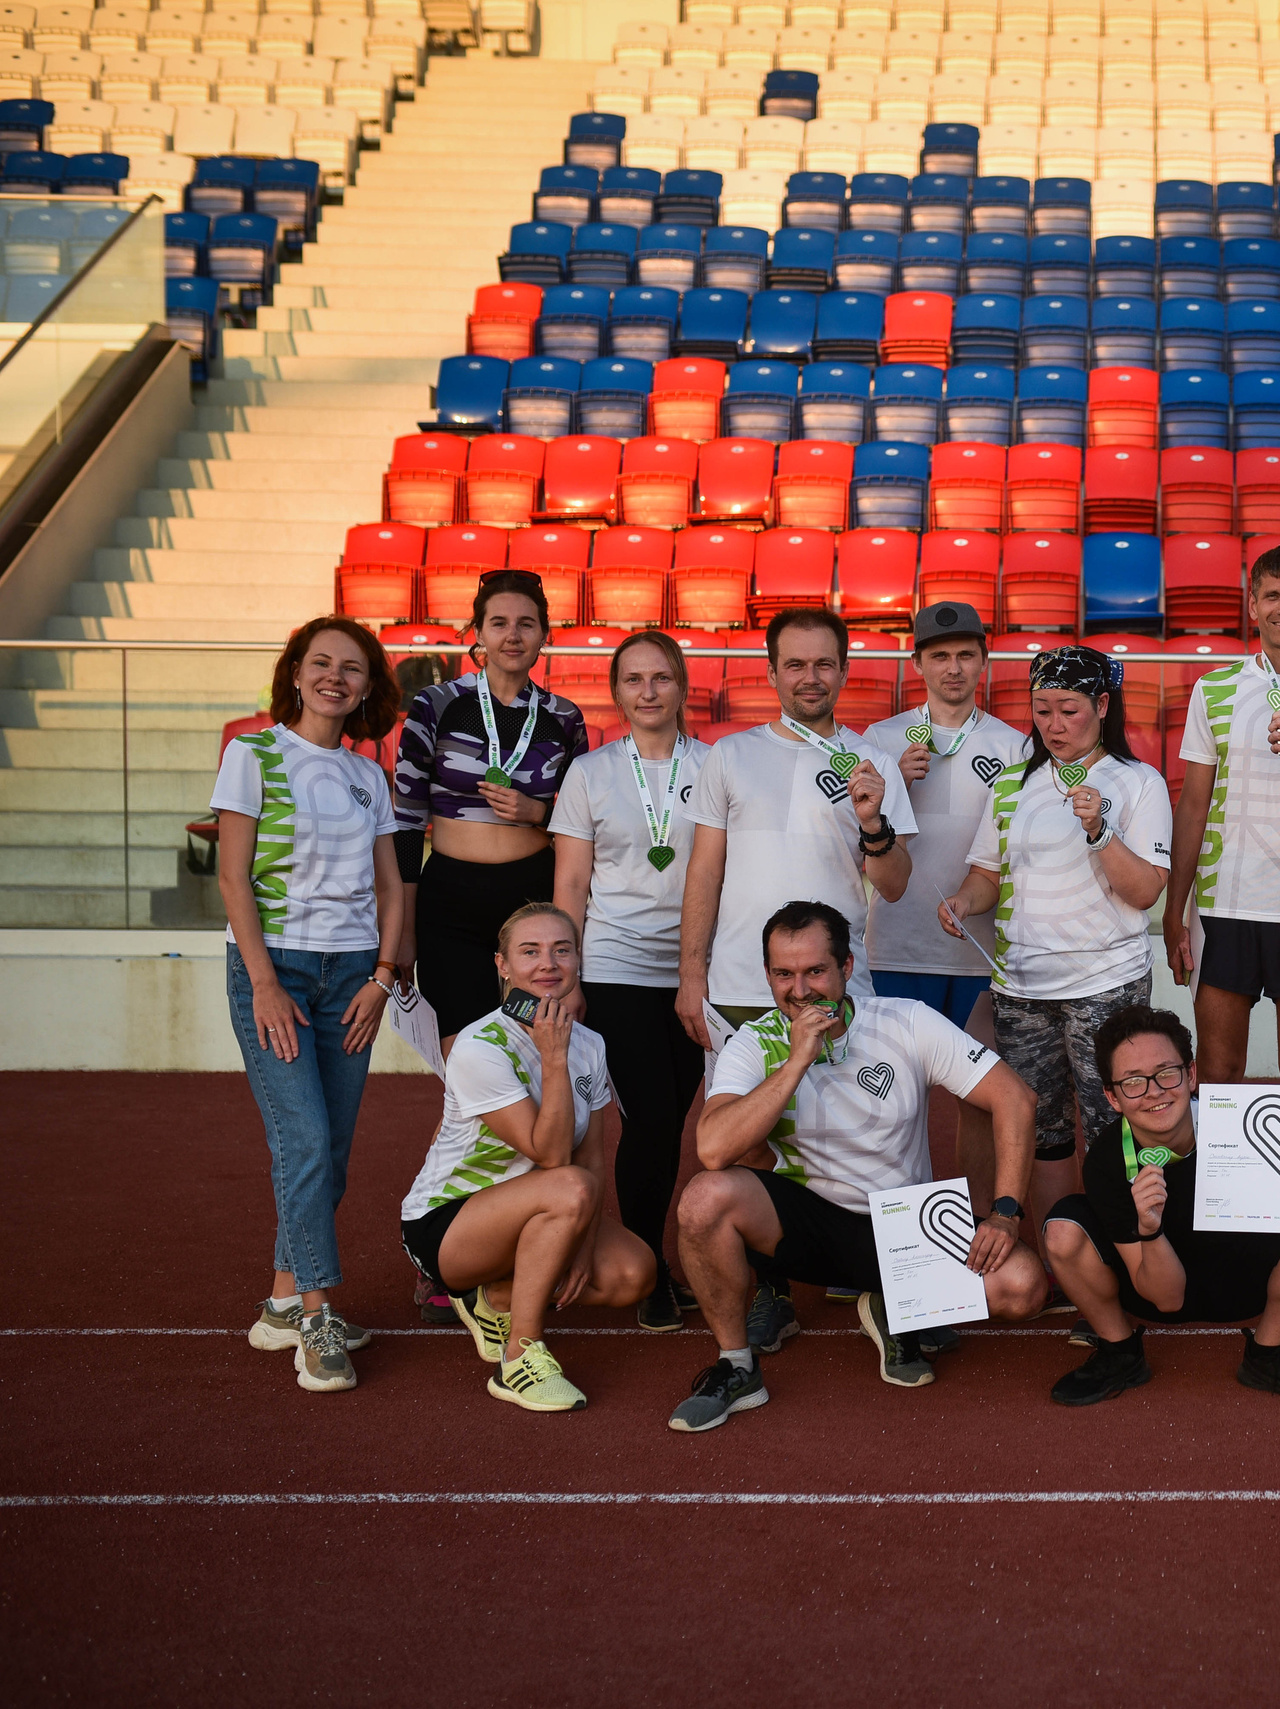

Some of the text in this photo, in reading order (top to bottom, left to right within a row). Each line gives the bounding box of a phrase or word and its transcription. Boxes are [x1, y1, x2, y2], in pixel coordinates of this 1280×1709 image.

[633, 761, 646, 789] RUNNING
[669, 758, 680, 786] RUNNING
[882, 1205, 911, 1216] RUNNING
[889, 1244, 920, 1254] Сертификат
